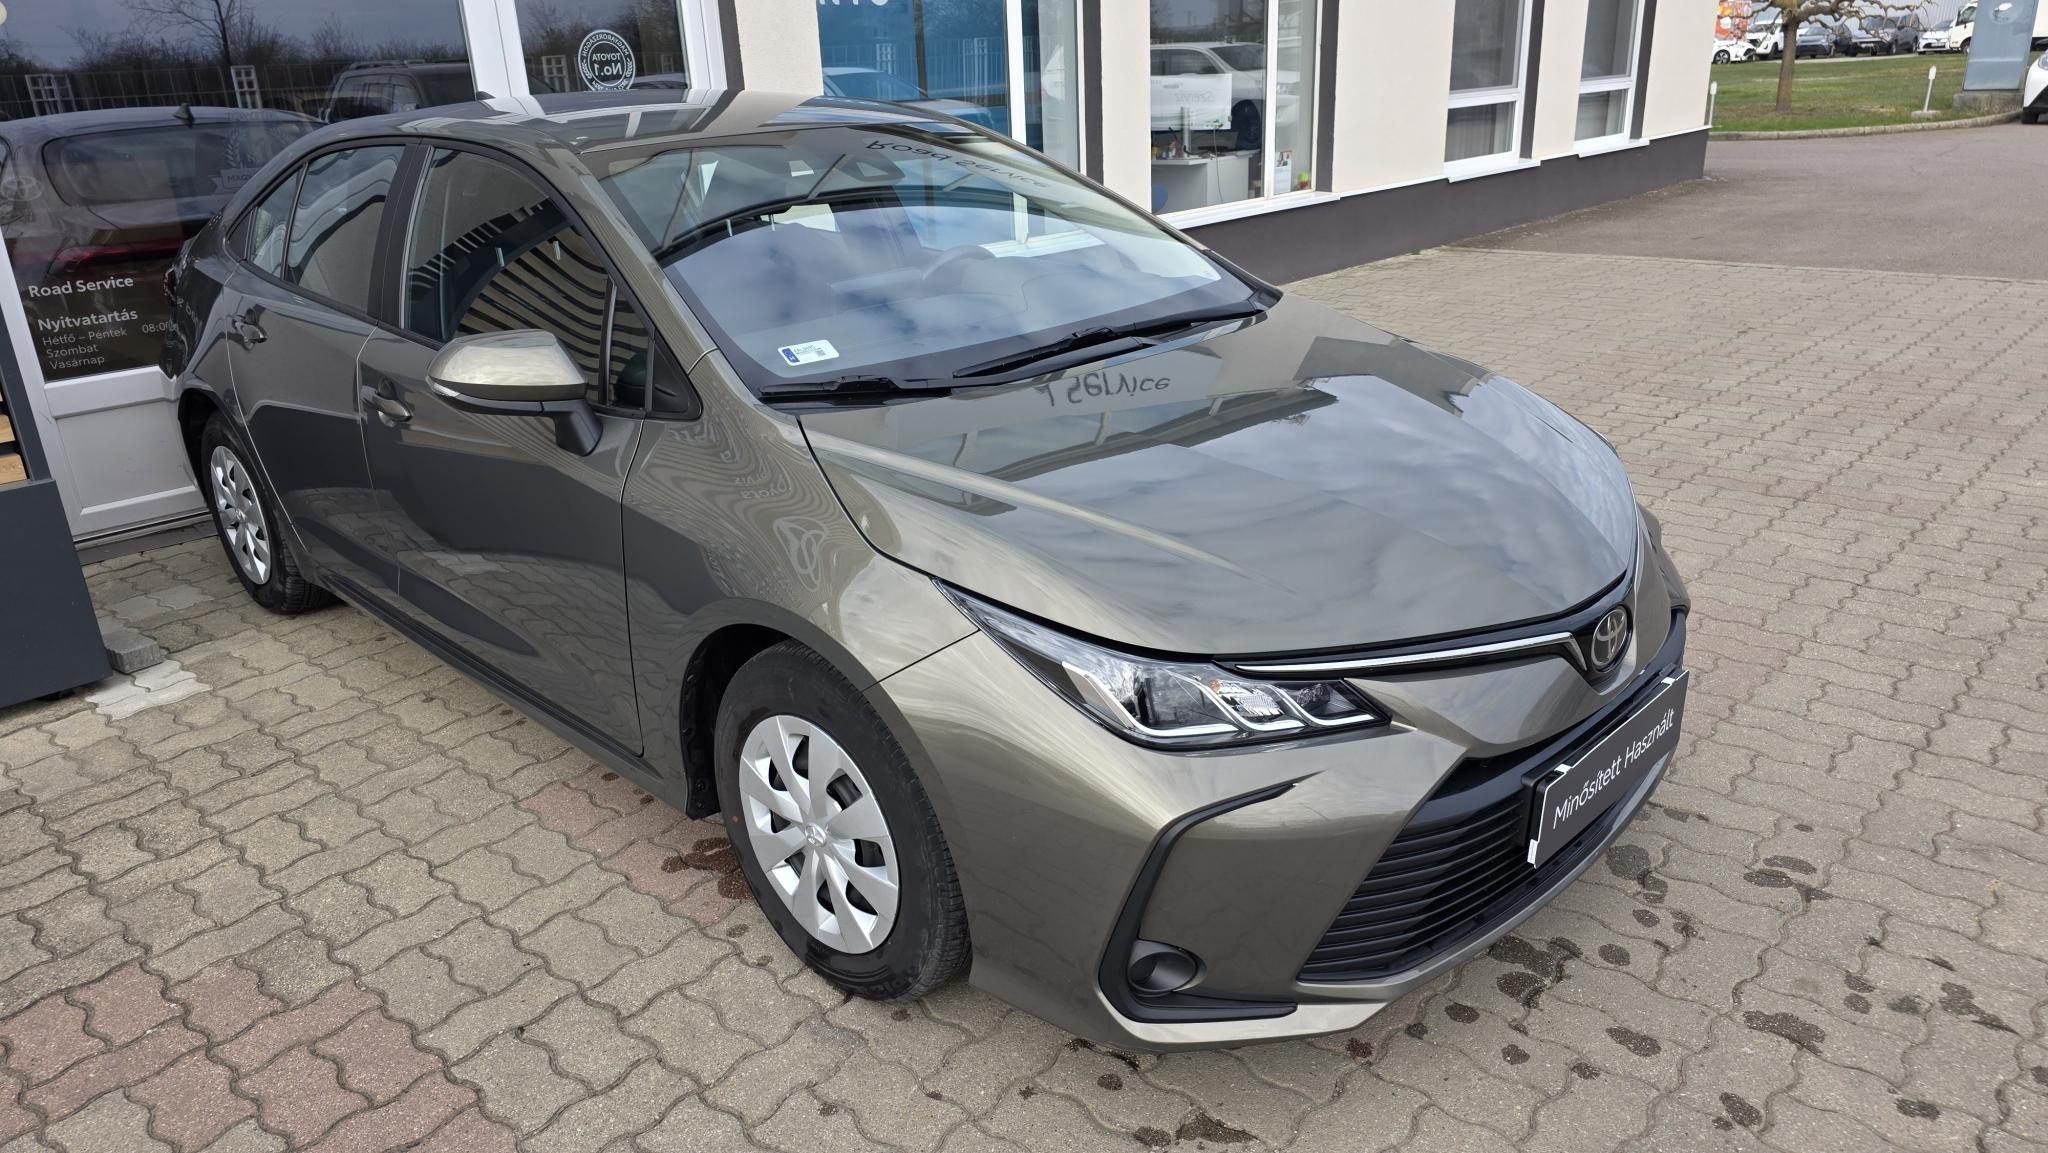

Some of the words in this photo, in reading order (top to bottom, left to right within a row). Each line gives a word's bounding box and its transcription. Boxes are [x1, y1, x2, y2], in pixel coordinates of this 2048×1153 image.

[28, 281, 73, 298] Road
[76, 275, 134, 293] Service
[37, 308, 139, 333] Nyitvatartás
[88, 327, 128, 341] Péntek
[46, 343, 99, 359] Szombat
[49, 355, 105, 371] Vasárnap
[1552, 756, 1623, 831] Minősített
[1623, 708, 1675, 769] Használt
